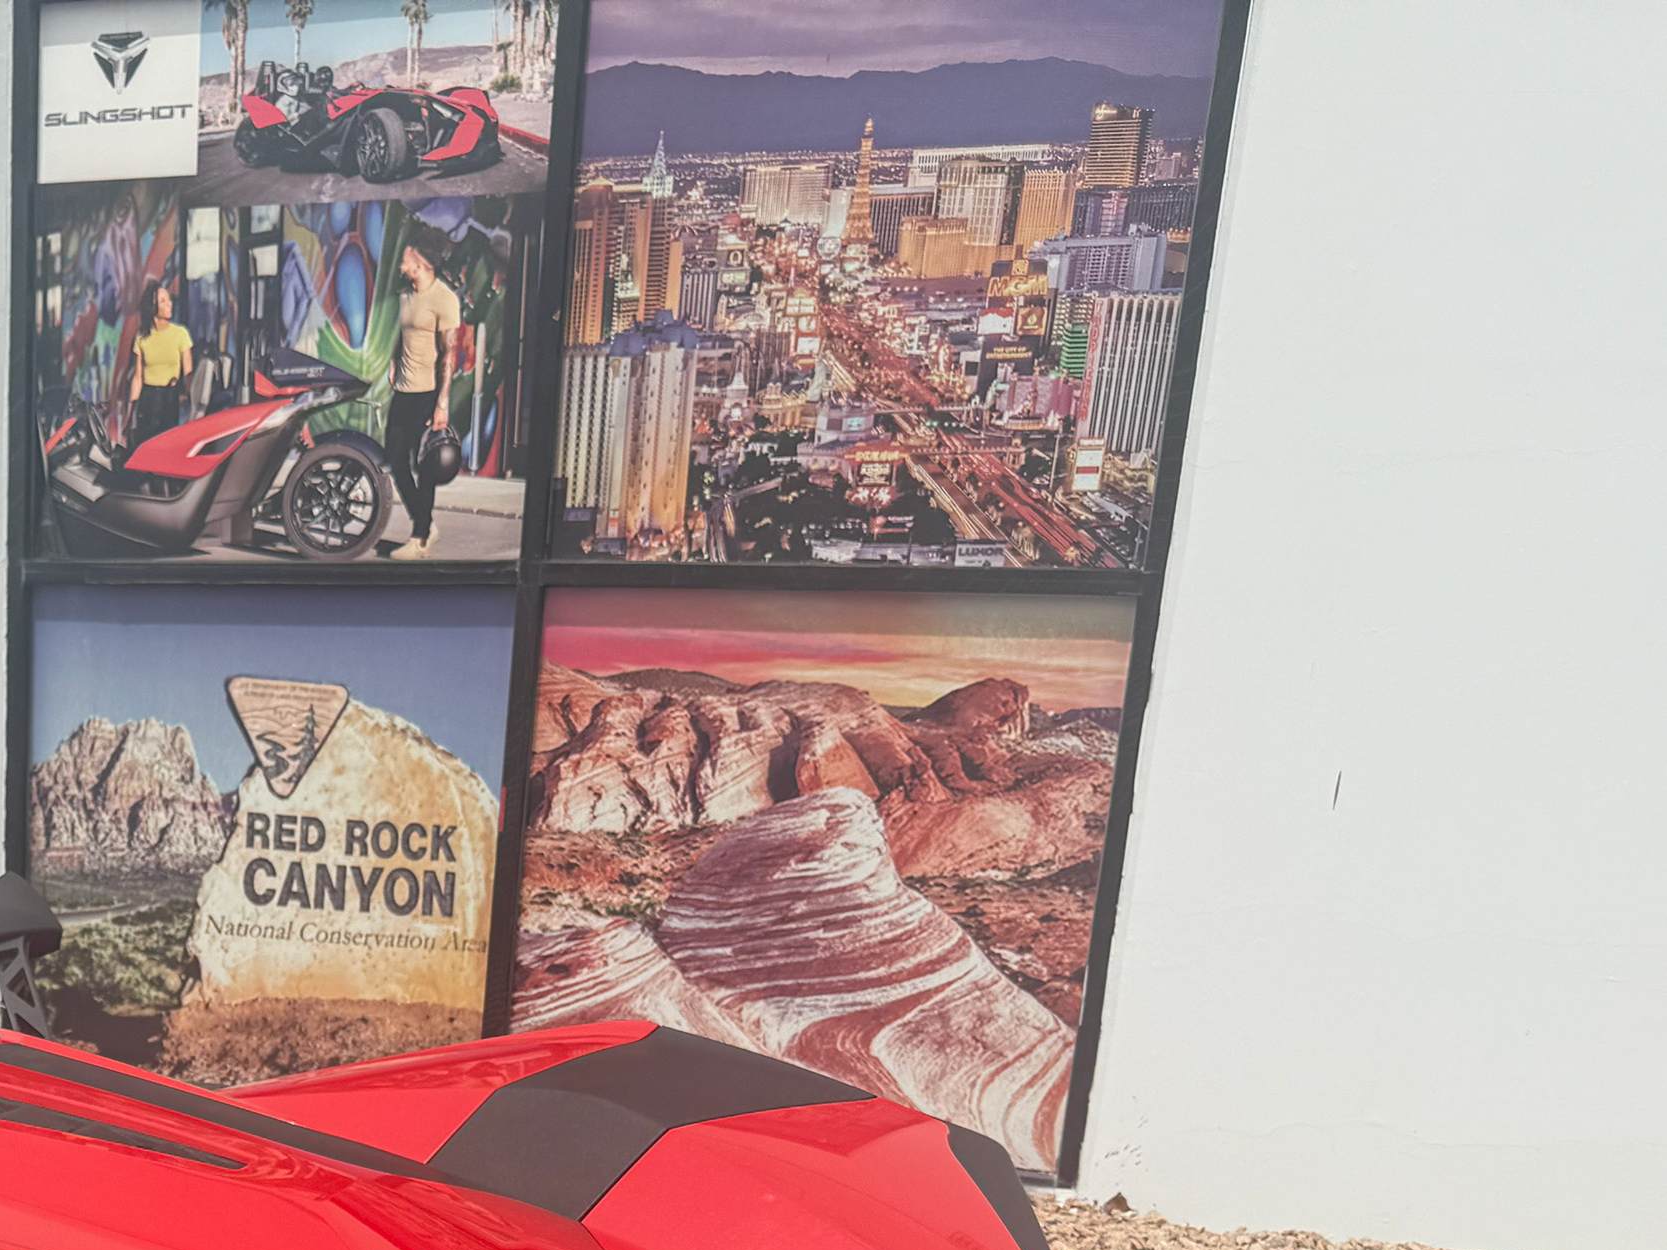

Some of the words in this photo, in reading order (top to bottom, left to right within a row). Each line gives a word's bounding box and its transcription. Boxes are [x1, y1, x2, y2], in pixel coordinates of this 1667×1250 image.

[44, 104, 193, 127] SLINGSHOT
[987, 275, 1048, 297] MGM
[958, 547, 1004, 557] LUXOR
[245, 811, 326, 853] RED
[344, 819, 457, 862] ROCK
[243, 857, 456, 918] CANYON
[204, 914, 293, 942] National
[299, 922, 436, 950] Conservation
